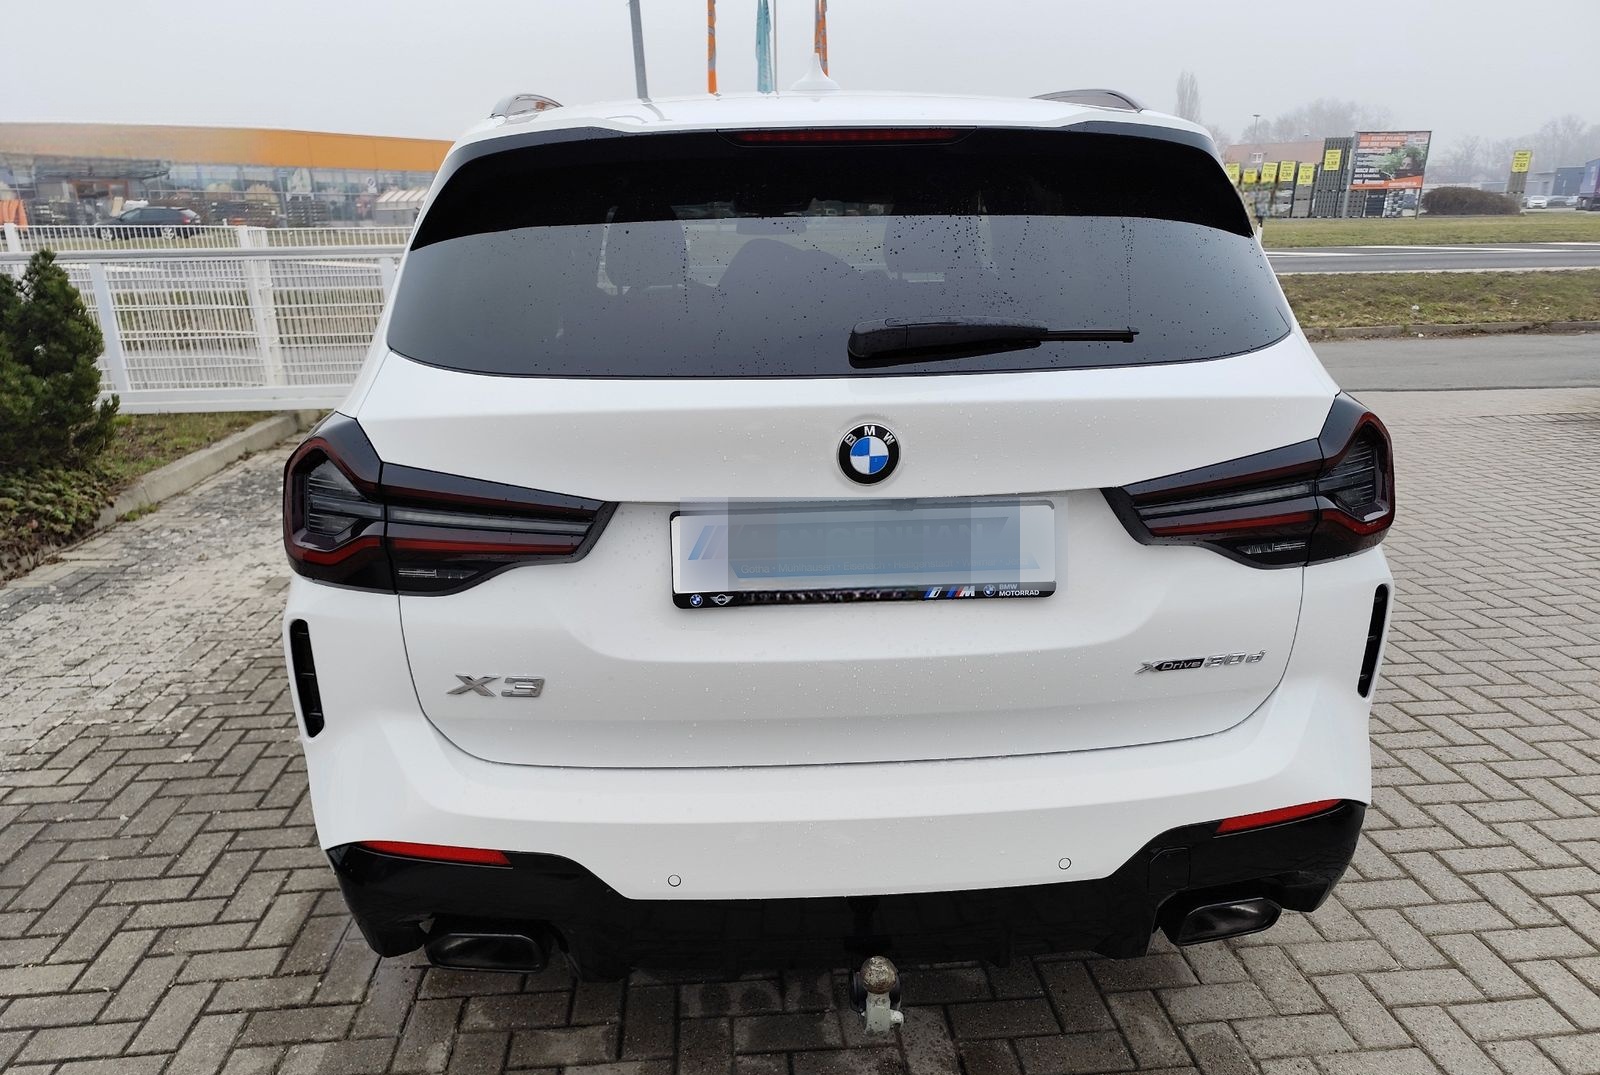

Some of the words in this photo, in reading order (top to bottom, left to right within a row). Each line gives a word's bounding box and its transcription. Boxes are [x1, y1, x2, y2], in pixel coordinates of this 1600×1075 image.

[844, 425, 896, 447] BMW
[740, 564, 770, 574] Gotha
[999, 589, 1040, 597] MOTORRAD
[446, 674, 545, 698] X3
